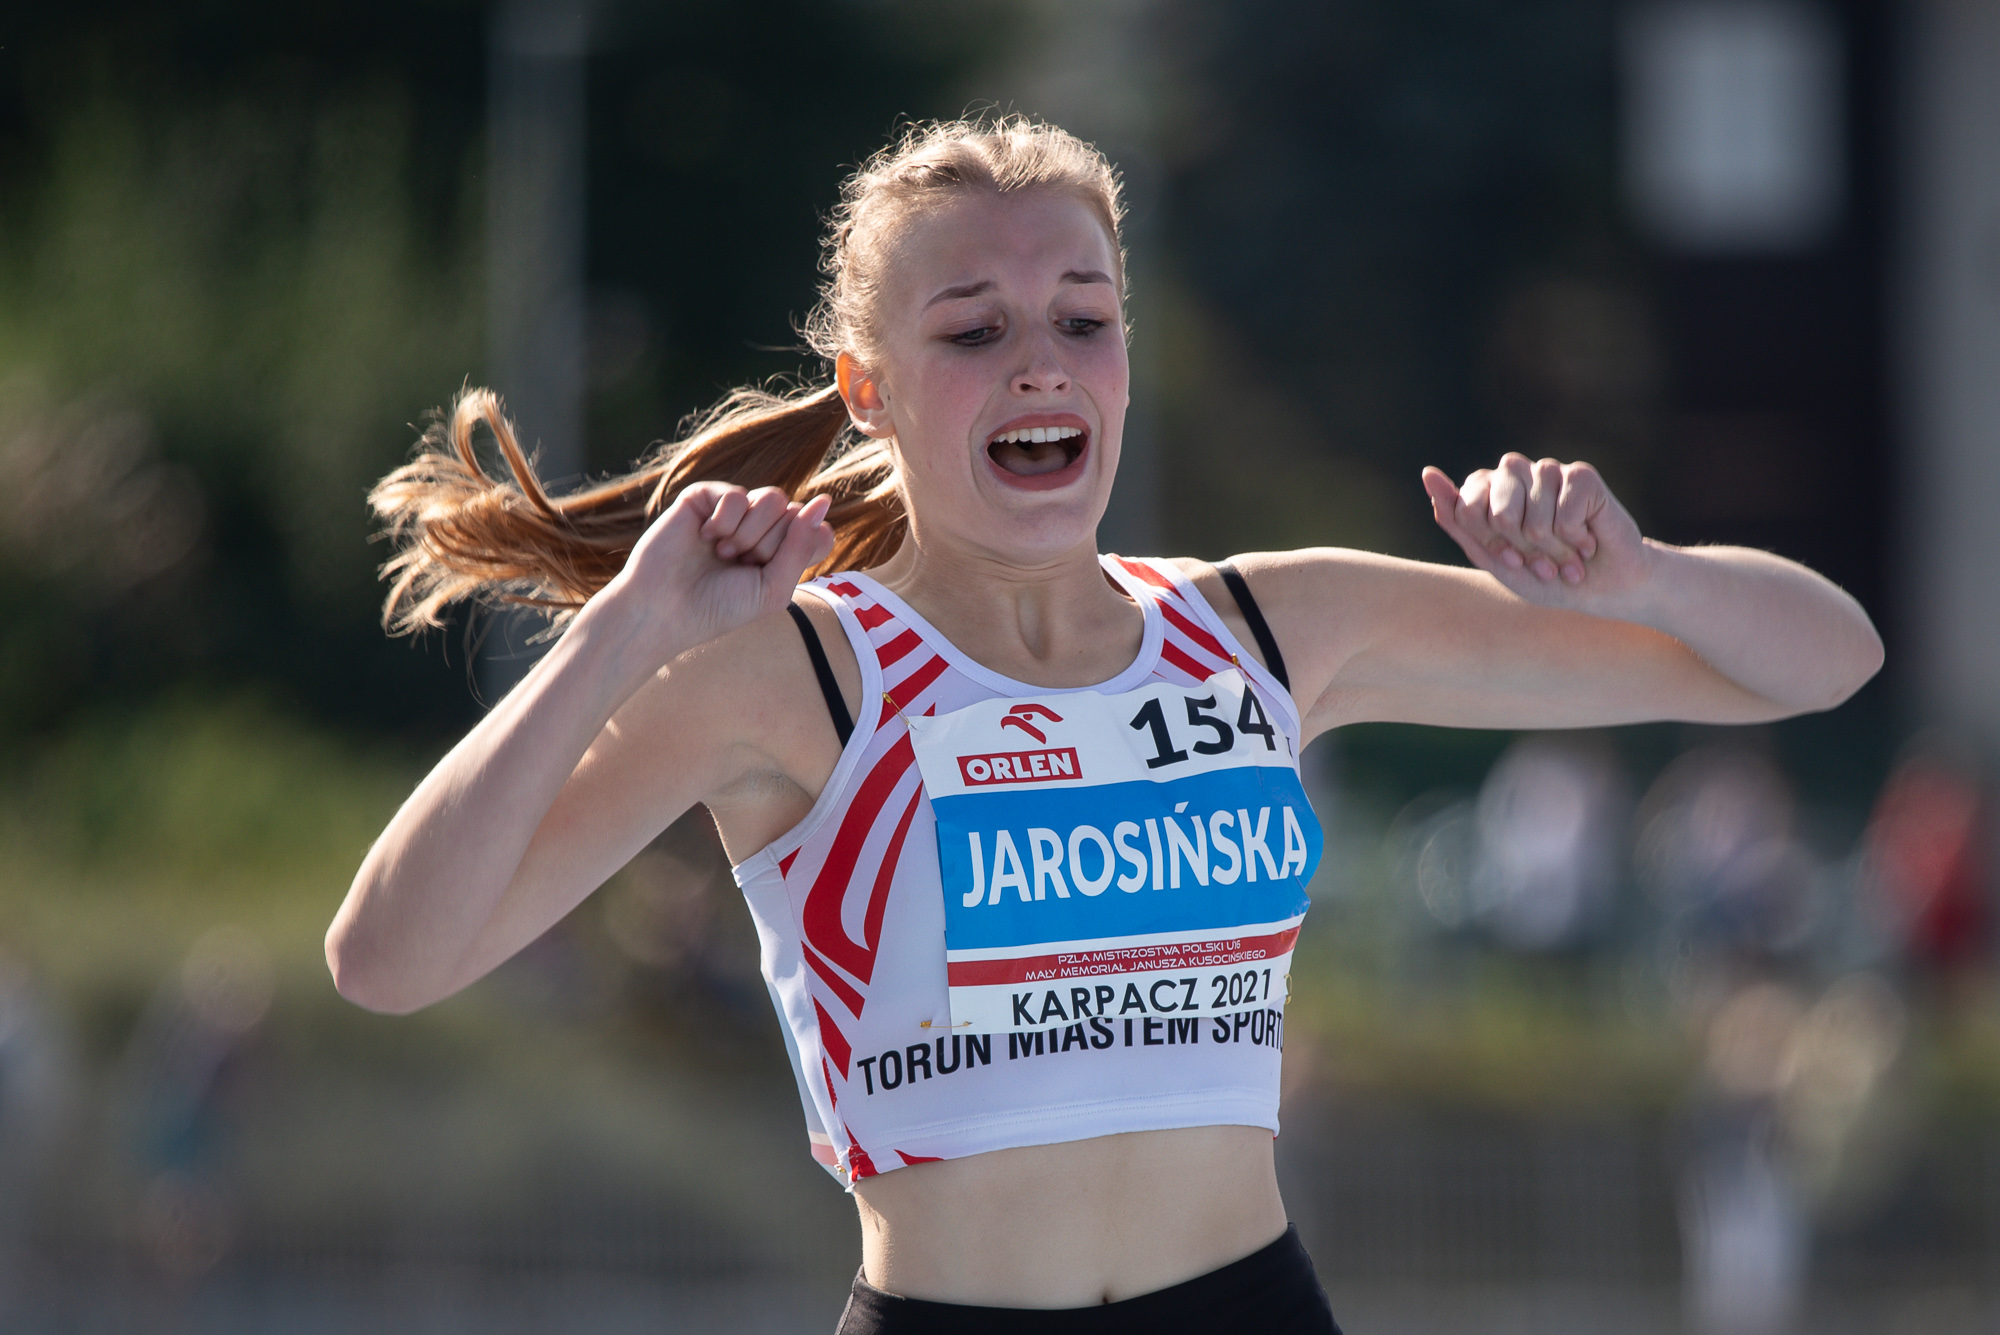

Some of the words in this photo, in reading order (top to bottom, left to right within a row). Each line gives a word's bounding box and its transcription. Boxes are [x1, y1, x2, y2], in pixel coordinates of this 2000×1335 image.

[1129, 683, 1276, 769] 154
[966, 751, 1075, 782] ORLEN
[962, 801, 1307, 908] JAROSIŃSKA
[1025, 968, 1057, 981] MAŁY
[1060, 963, 1127, 977] MEMORIAŁ
[1129, 957, 1187, 971] JANUSZA
[1188, 949, 1267, 967] KUSOCIŃSKIEGO
[1058, 953, 1091, 965] PZLA
[1092, 945, 1180, 962] MISTRZOSTWA
[1182, 941, 1224, 954] POLSKI
[1226, 939, 1241, 951] U16
[1011, 977, 1199, 1026] KARPACZ
[1211, 968, 1272, 1009] 2021
[1009, 1017, 1199, 1060] MIASTEM
[1212, 1008, 1283, 1053] SPORT
